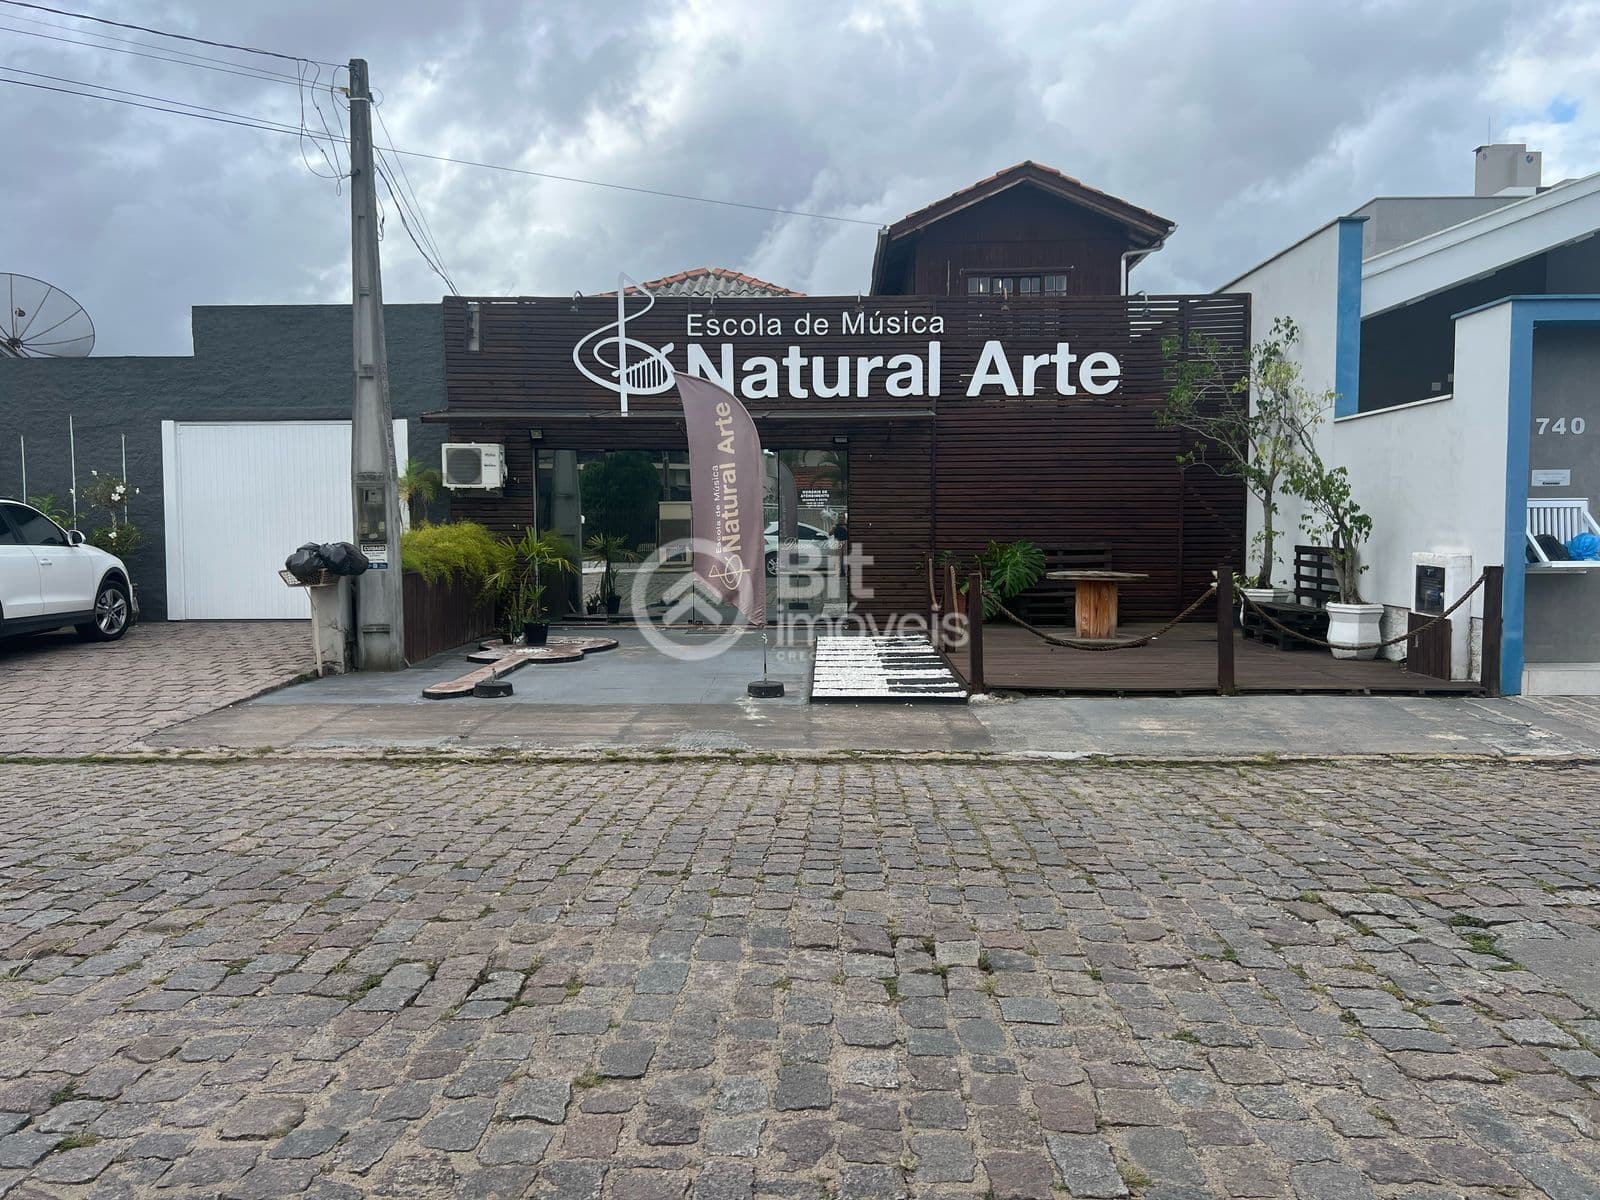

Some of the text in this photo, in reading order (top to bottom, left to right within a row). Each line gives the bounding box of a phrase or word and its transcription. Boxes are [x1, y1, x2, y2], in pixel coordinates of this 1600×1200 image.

[687, 310, 945, 336] Escola de Música
[687, 340, 1121, 399] Natural Arte
[1535, 416, 1586, 435] 740
[711, 465, 720, 501] Música
[715, 402, 742, 552] Natural Arte
